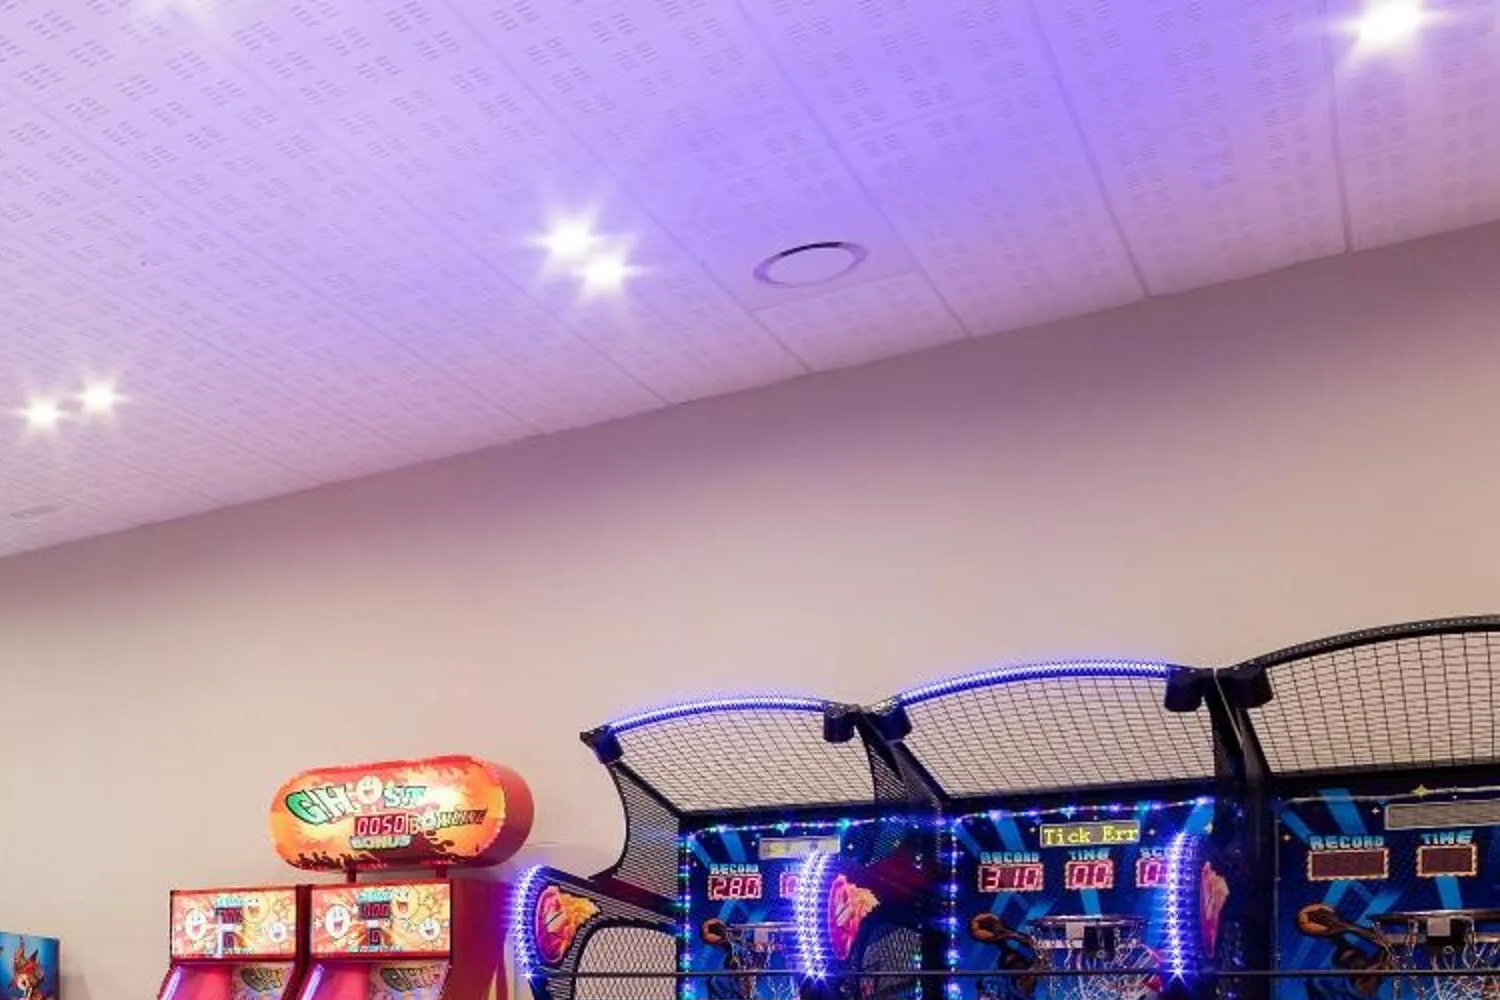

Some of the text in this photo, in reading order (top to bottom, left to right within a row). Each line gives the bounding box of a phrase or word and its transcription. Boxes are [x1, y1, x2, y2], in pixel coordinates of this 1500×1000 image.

[356, 815, 404, 836] 0050
[350, 835, 412, 850] BONUS
[1043, 826, 1138, 844] Tick Err
[1309, 835, 1385, 850] RECORD
[1420, 830, 1474, 845] TIME
[980, 851, 1040, 864] RECORD
[1068, 848, 1110, 860] TIME
[709, 863, 759, 875] RECORD
[1071, 861, 1109, 886] 00
[712, 877, 759, 900] 280
